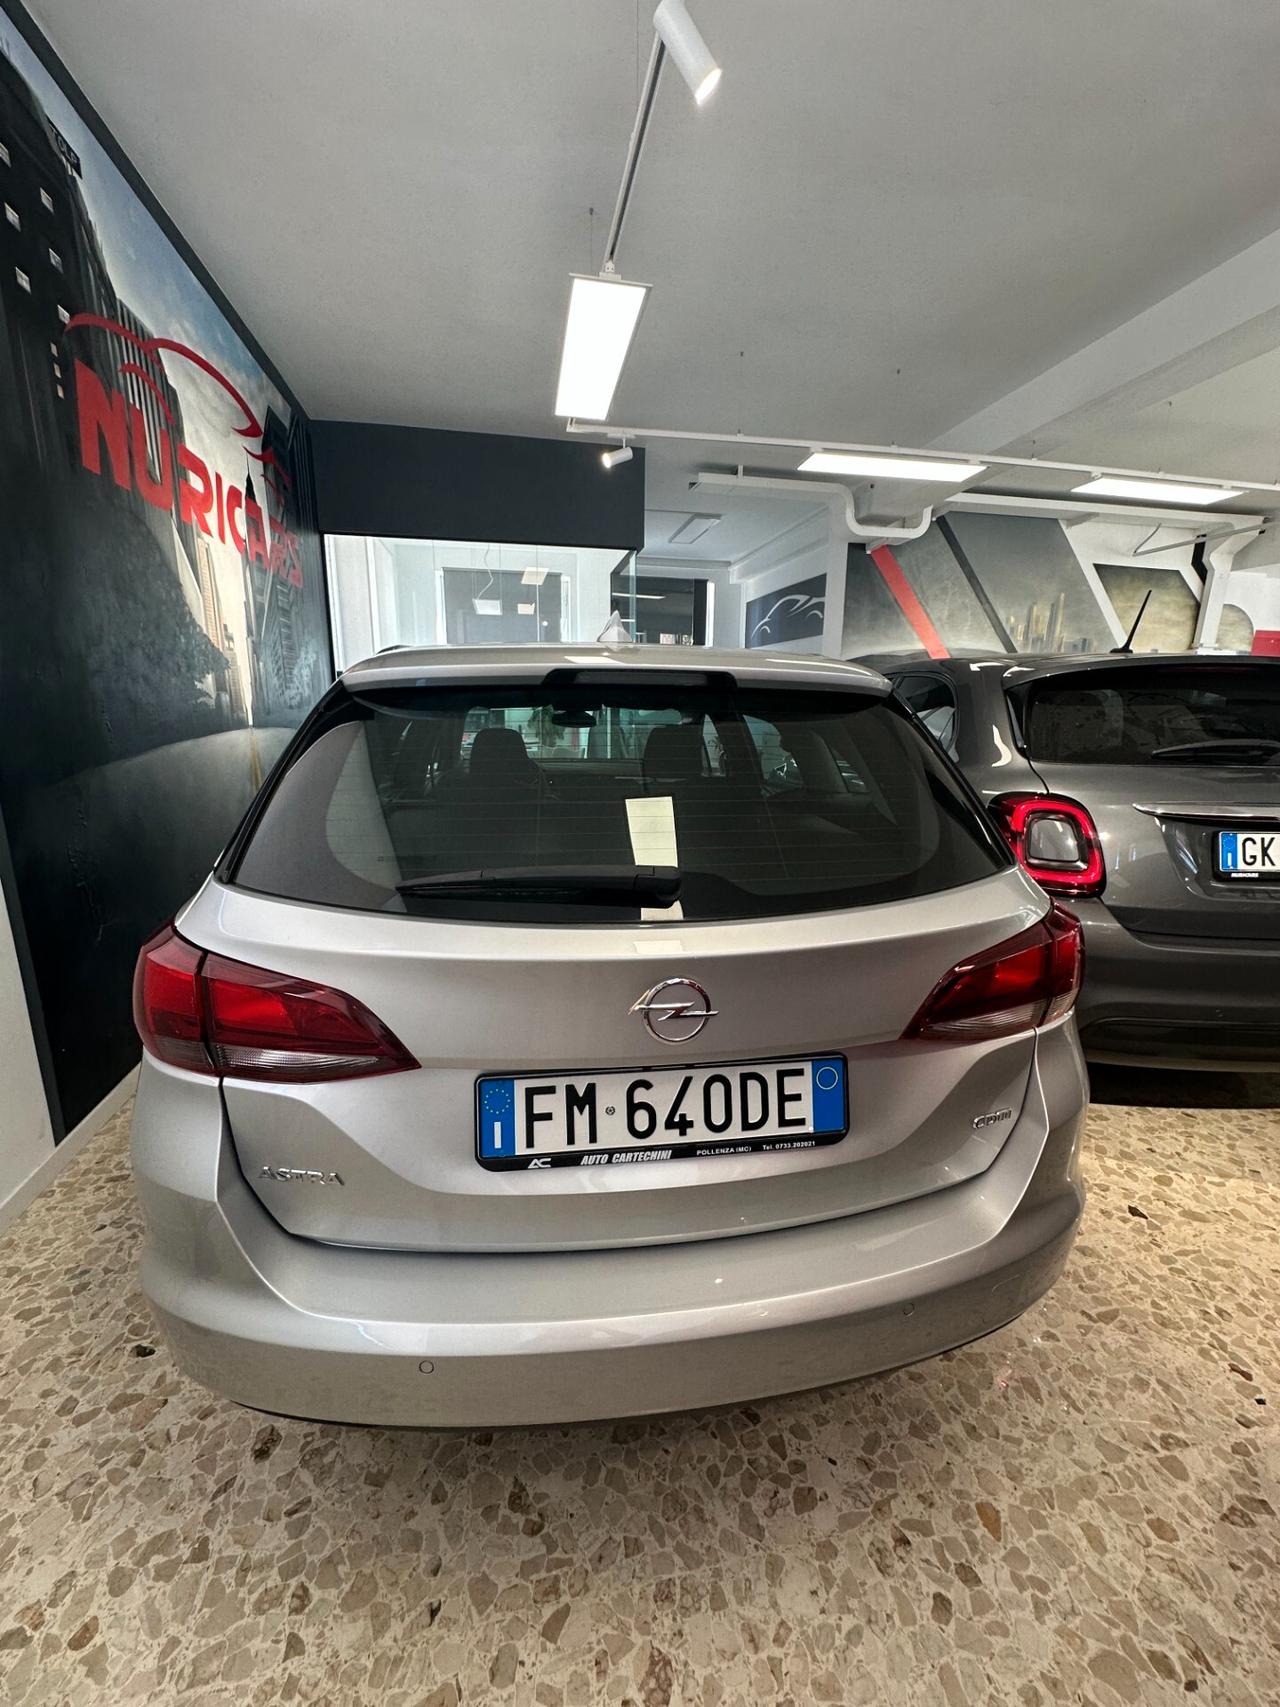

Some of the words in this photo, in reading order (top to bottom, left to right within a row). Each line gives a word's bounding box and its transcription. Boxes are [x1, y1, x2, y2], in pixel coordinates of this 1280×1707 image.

[1241, 836, 1276, 867] GK
[524, 1082, 598, 1149] FM
[625, 1067, 807, 1141] 640DE
[580, 1153, 609, 1166] AUTO
[611, 1149, 673, 1164] CARTECHINI
[696, 1146, 735, 1156] POLLENZA
[735, 1145, 752, 1154] (MC)
[258, 1166, 345, 1186] ASTRA
